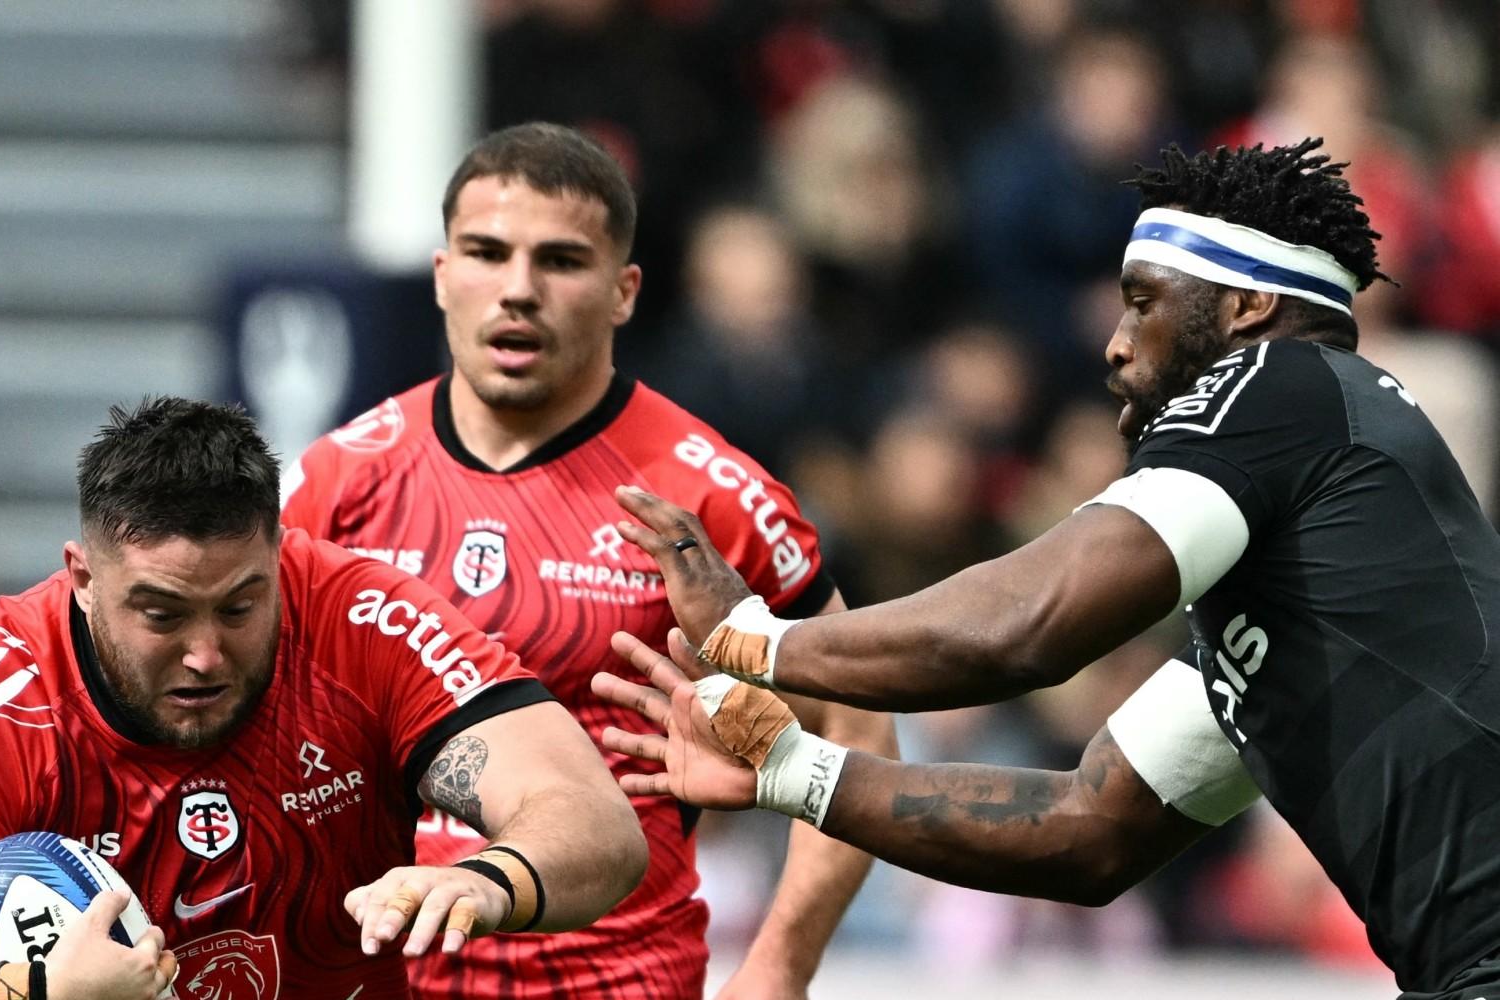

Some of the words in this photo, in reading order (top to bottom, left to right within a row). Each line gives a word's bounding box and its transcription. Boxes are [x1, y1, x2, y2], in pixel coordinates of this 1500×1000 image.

[674, 433, 812, 591] actual
[539, 559, 662, 592] REMPART
[281, 770, 364, 812] REMPAR
